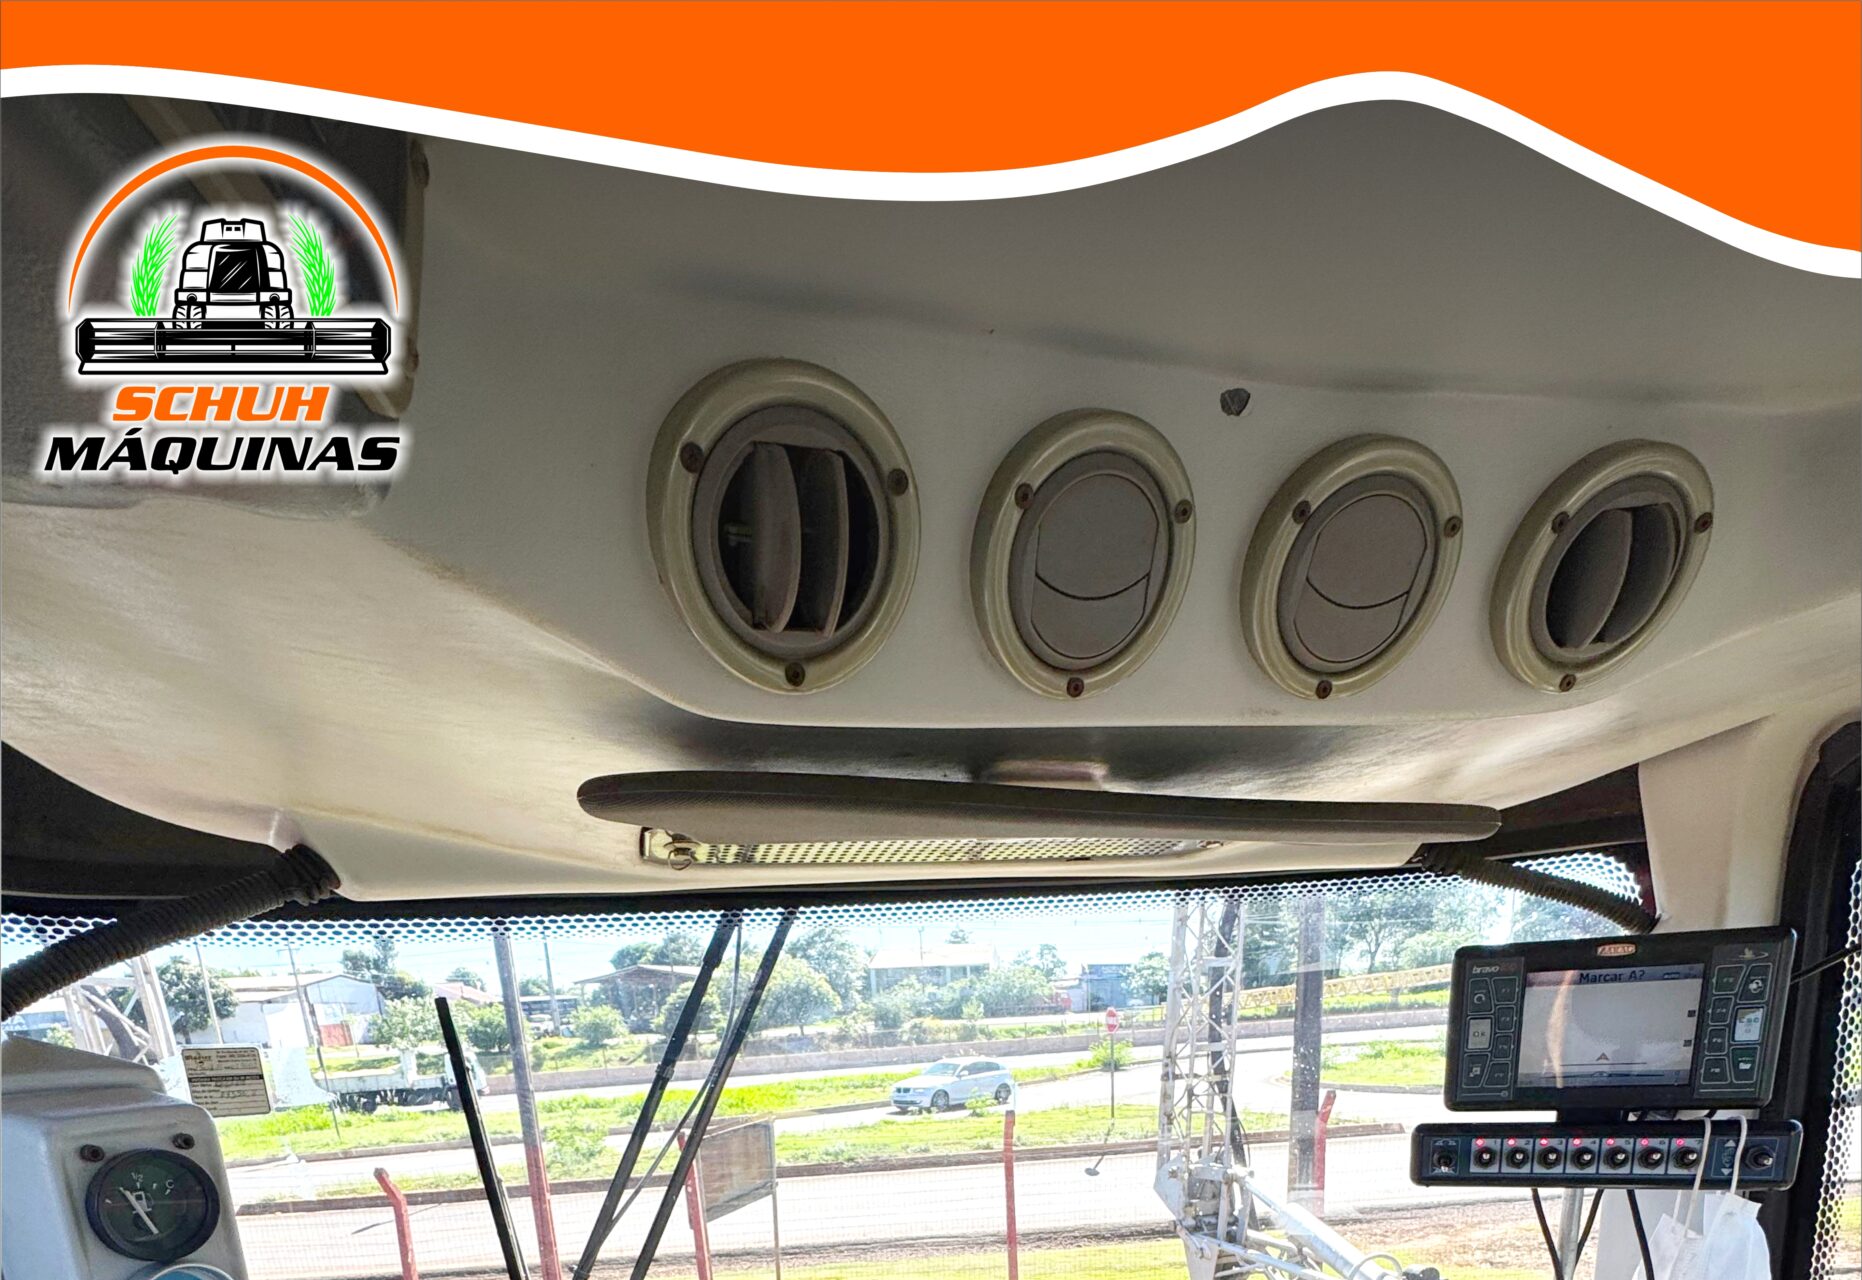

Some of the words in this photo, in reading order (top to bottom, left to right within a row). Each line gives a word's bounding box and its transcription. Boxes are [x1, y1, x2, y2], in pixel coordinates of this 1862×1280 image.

[1472, 964, 1500, 975] bravo
[1579, 971, 1623, 984] Marcar
[1627, 969, 1646, 981] A?
[165, 1179, 175, 1189] C
